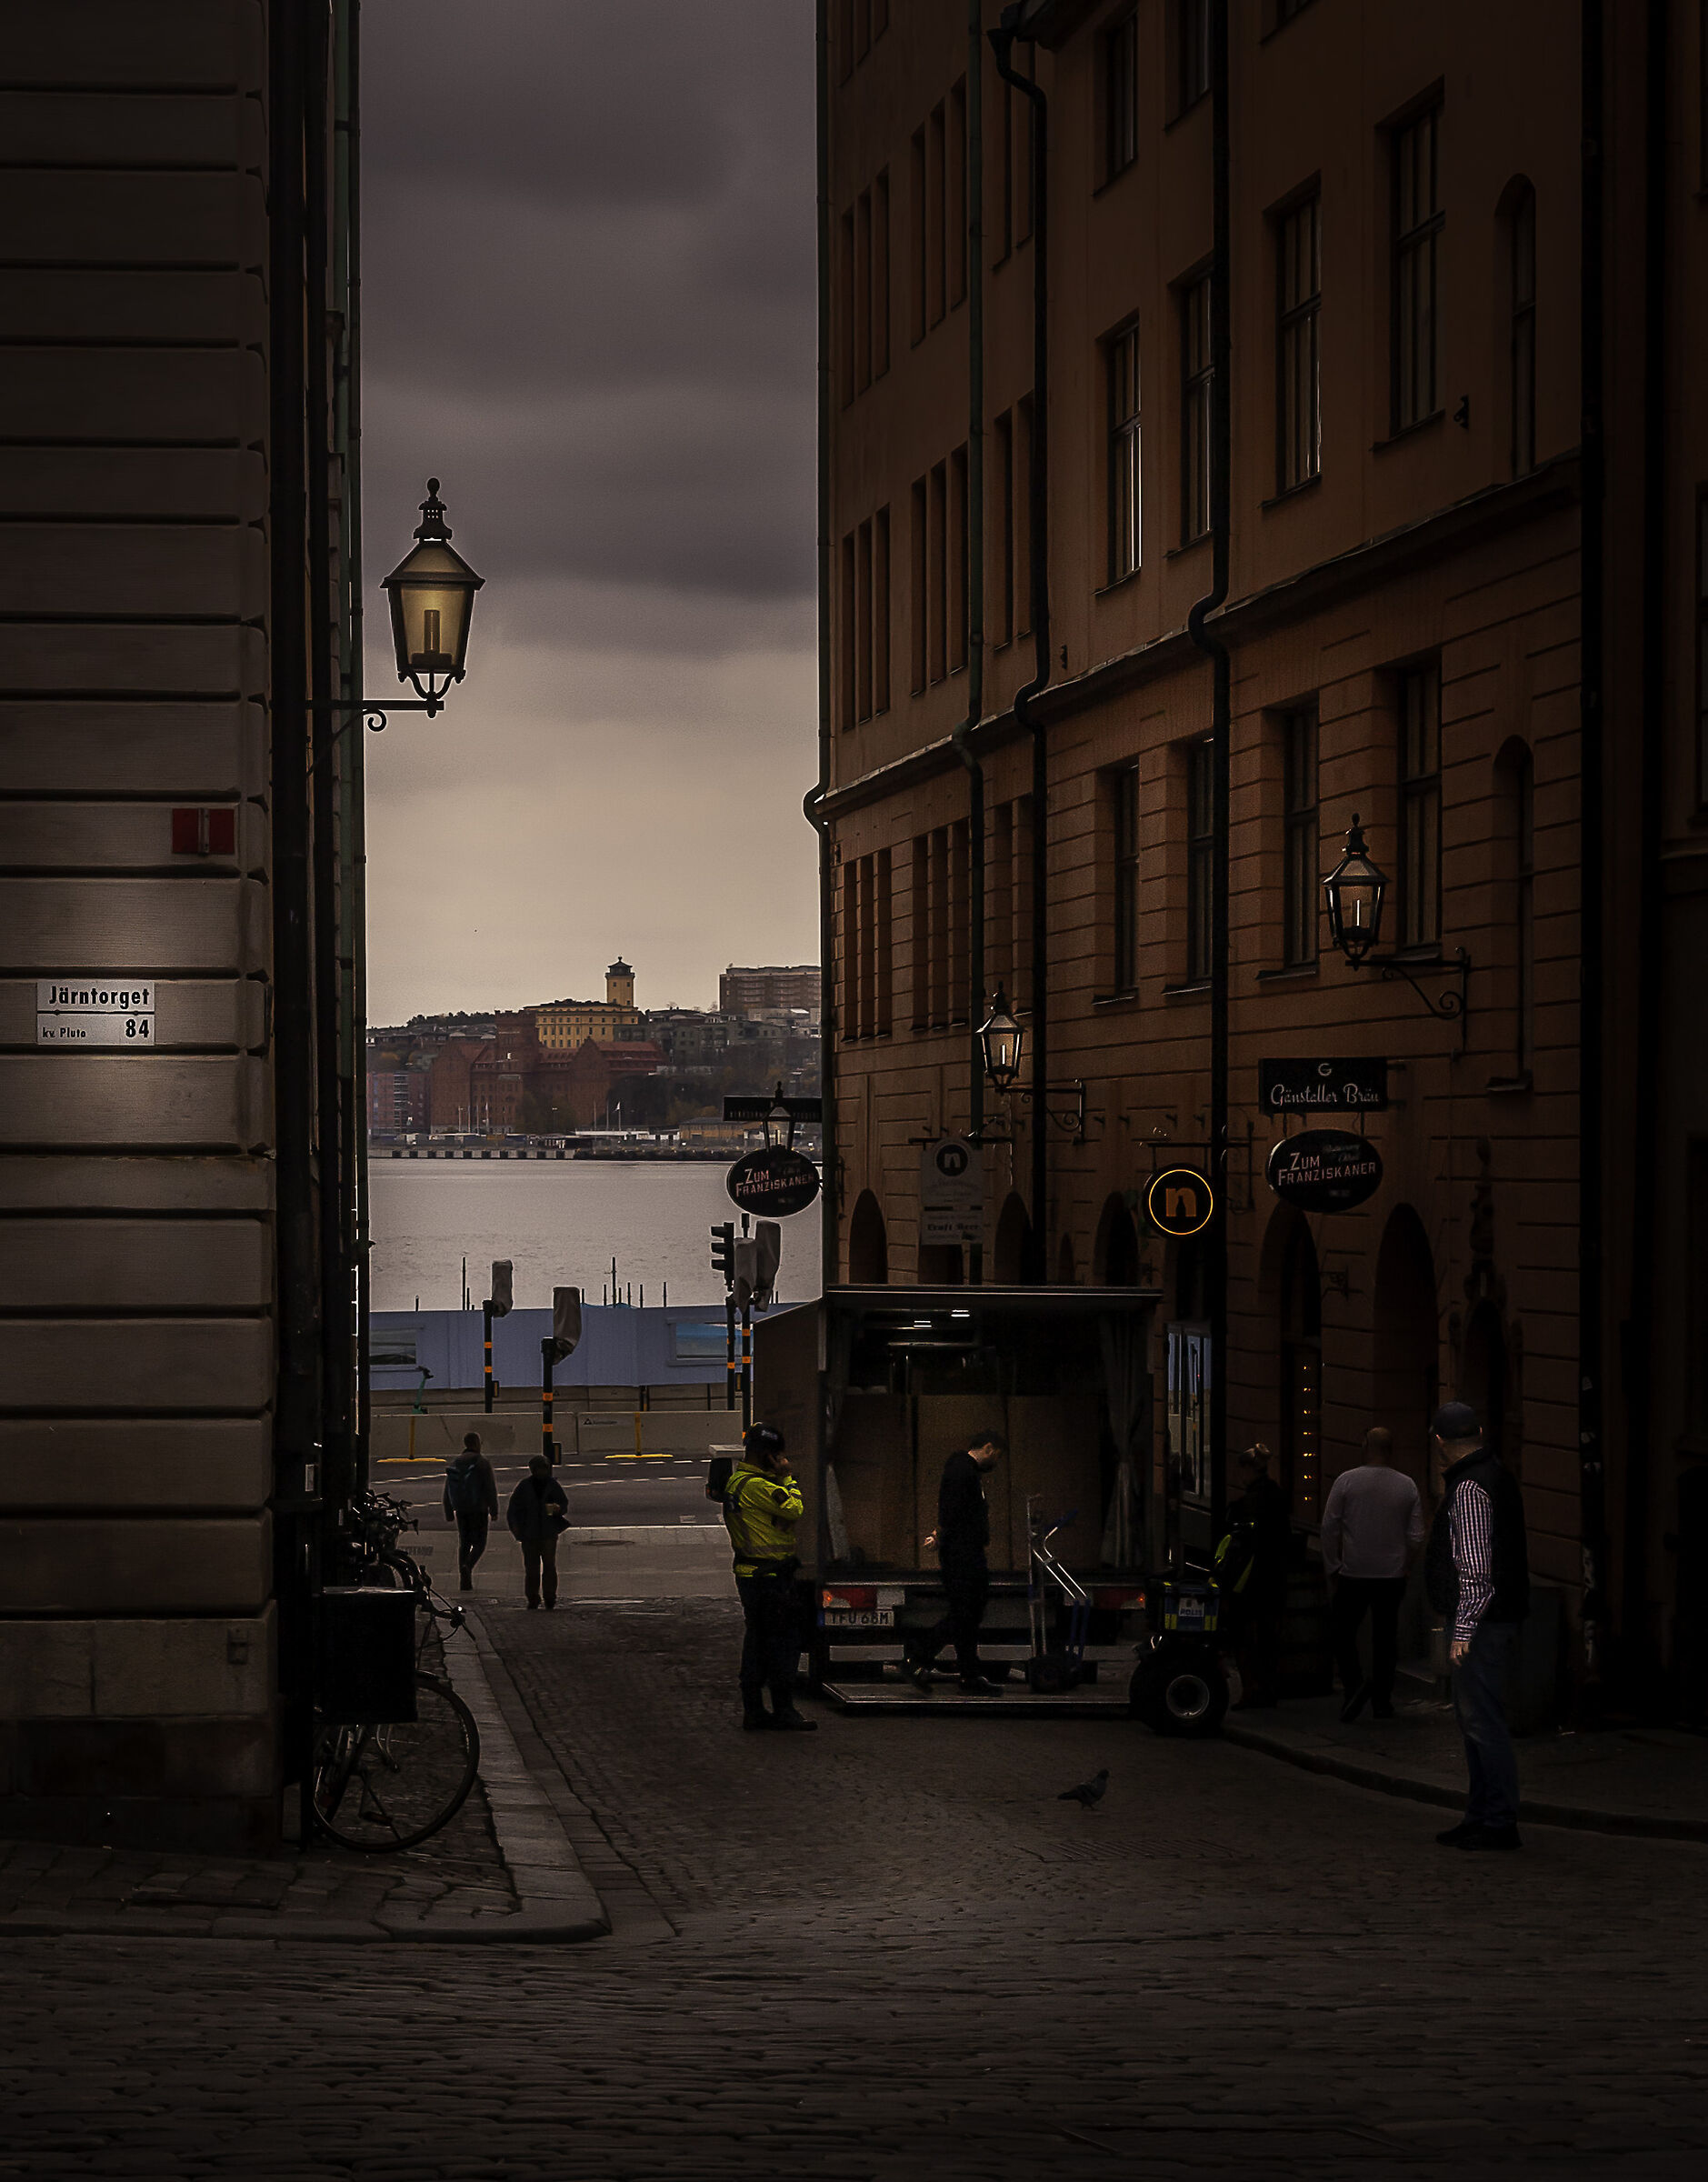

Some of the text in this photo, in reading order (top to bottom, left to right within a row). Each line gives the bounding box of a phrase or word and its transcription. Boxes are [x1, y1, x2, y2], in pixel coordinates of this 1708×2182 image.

[49, 986, 149, 1009] Järntorget
[60, 1027, 85, 1037] Pluto
[125, 1019, 149, 1037] 84
[1343, 1083, 1380, 1104] Bräu
